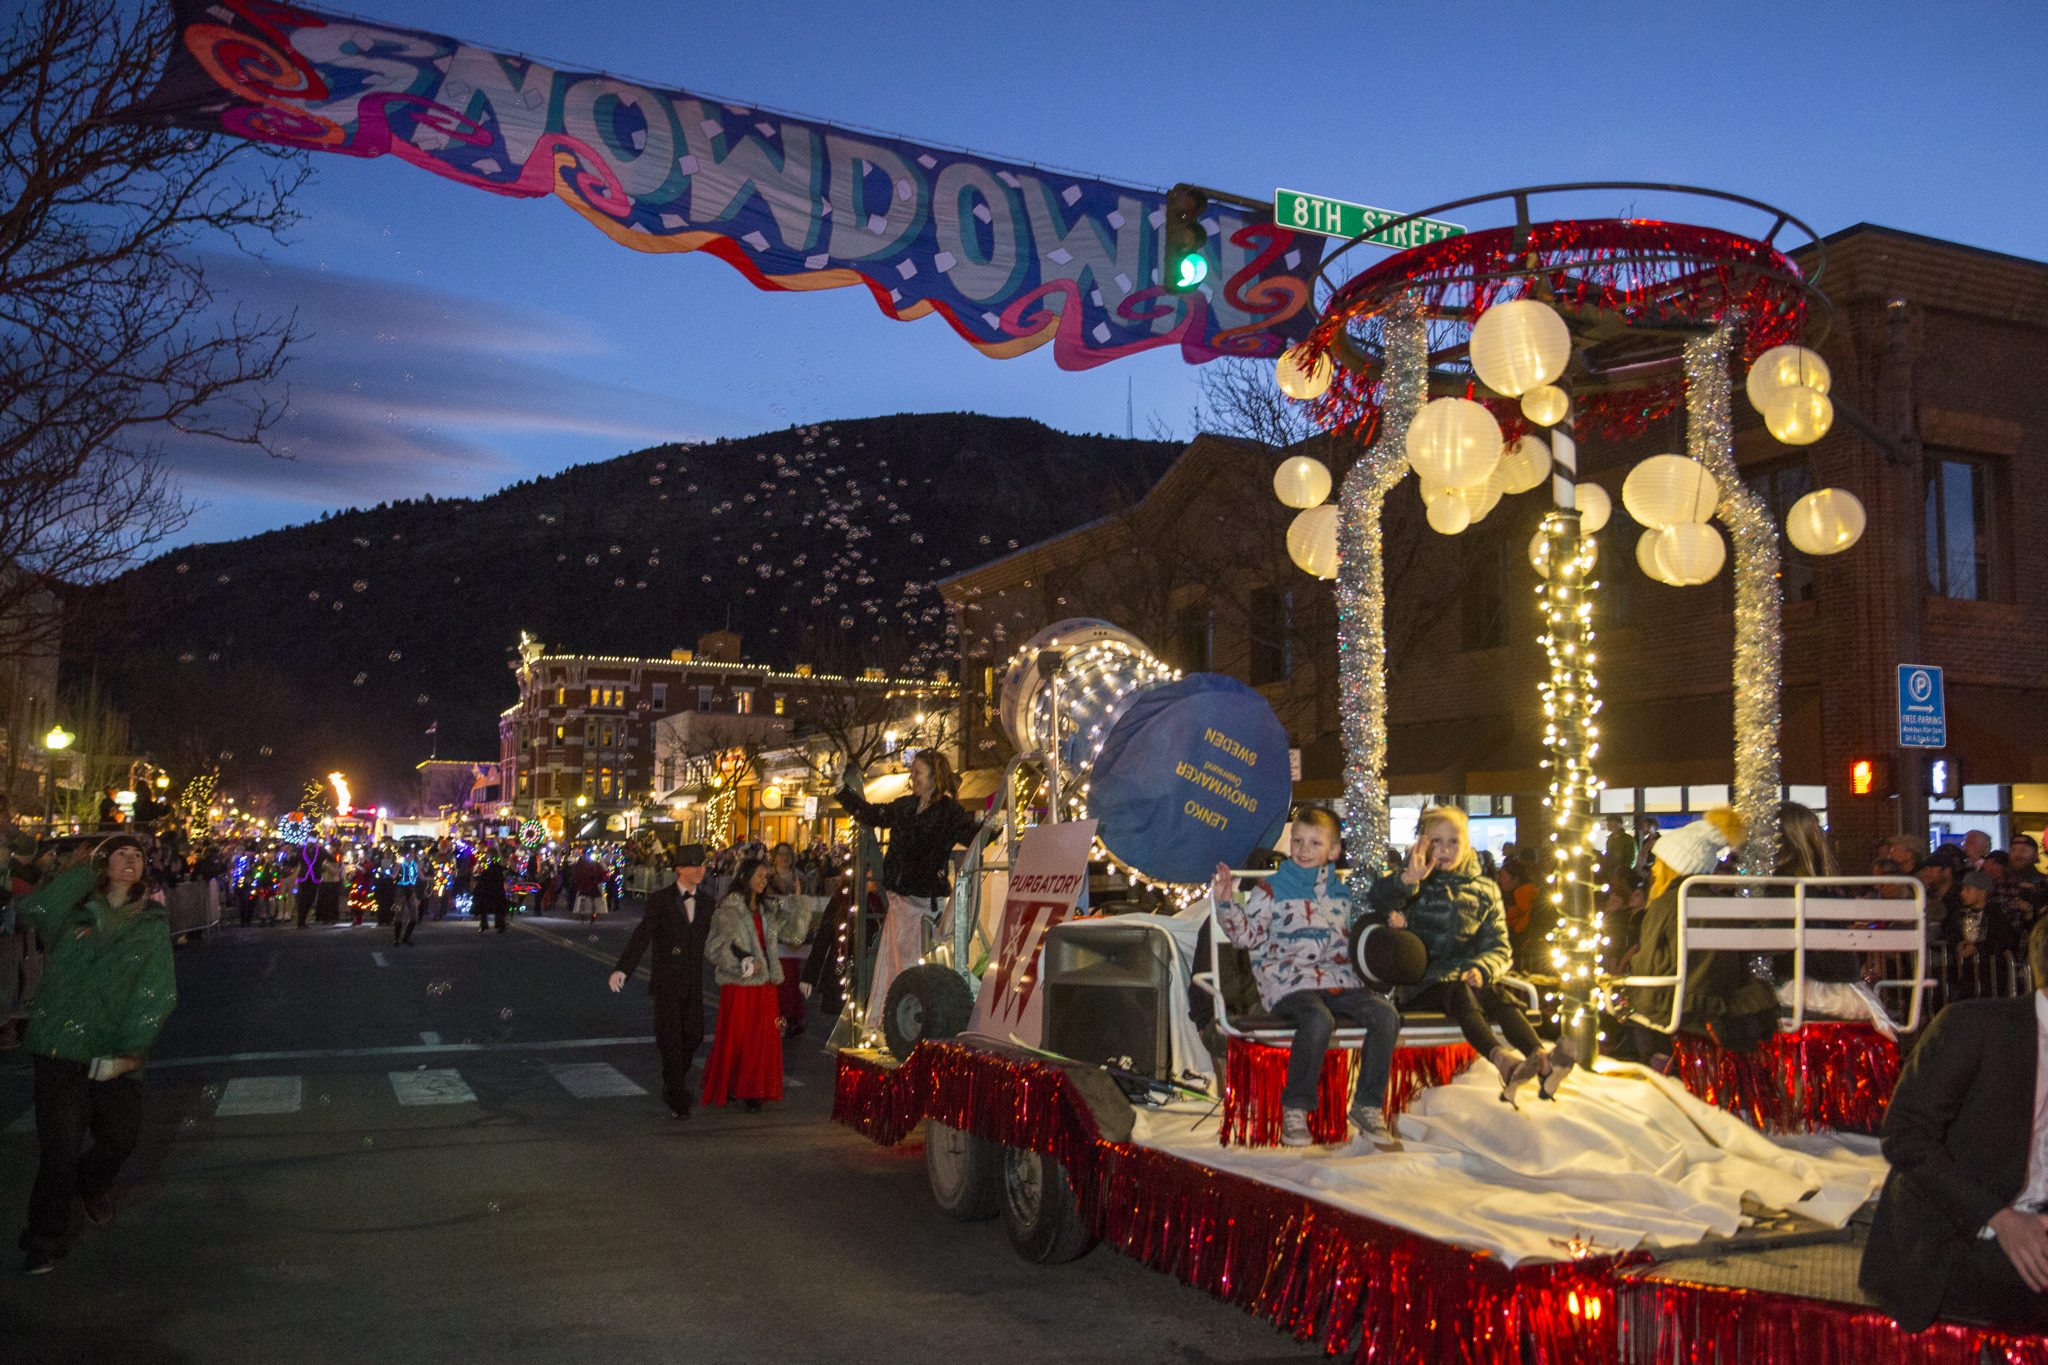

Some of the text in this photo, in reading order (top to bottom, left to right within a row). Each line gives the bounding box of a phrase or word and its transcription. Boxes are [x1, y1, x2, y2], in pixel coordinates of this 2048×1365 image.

[268, 22, 1258, 335] SNOWDOWN
[1294, 196, 1341, 233] 8TH
[1916, 676, 1927, 693] P
[1903, 714, 1943, 724] FREE PARKING
[1204, 727, 1257, 767] SWEDEN
[1175, 760, 1257, 813] SNOWMAKER
[1184, 800, 1228, 831] LENKO
[1009, 874, 1083, 894] PURGATORY
